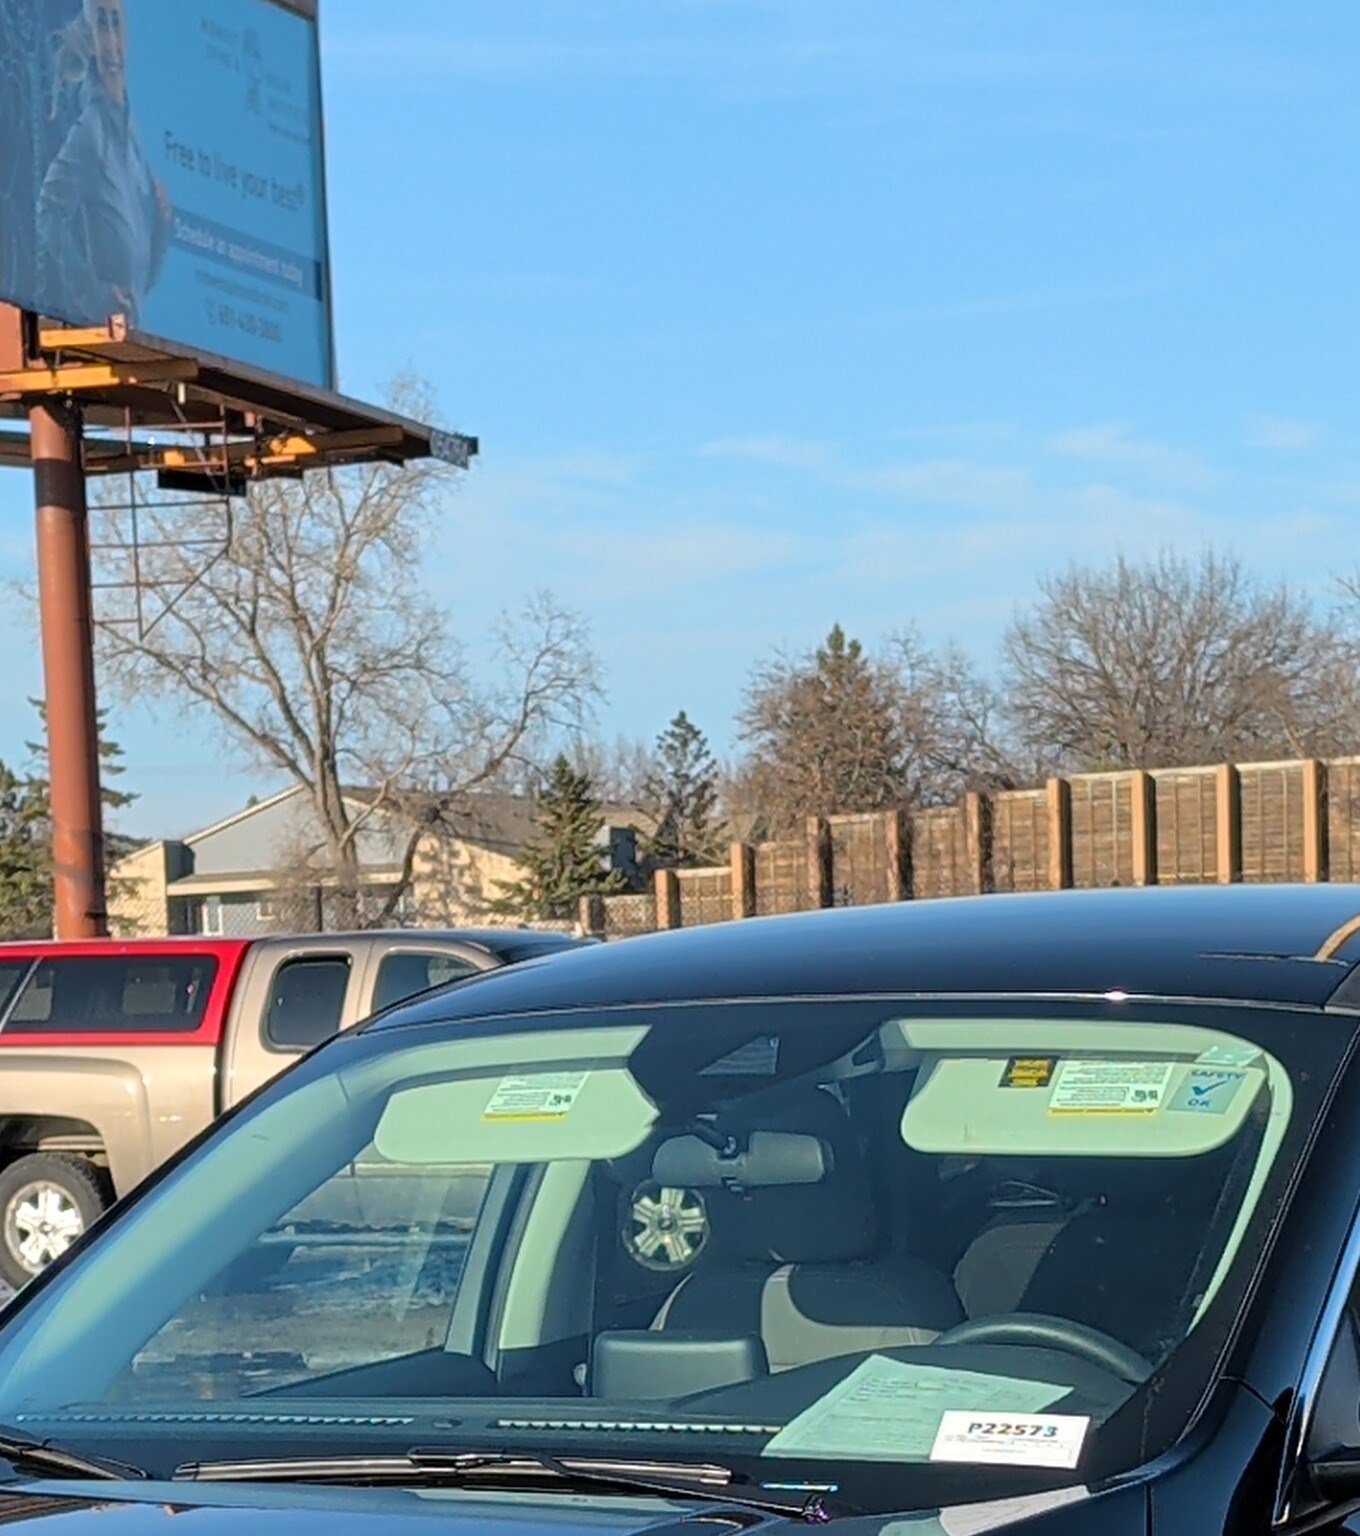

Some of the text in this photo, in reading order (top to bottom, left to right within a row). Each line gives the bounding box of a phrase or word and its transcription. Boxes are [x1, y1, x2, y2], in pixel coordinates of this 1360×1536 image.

[1191, 1069, 1247, 1080] SAFETY
[1188, 1098, 1211, 1107] OK
[967, 1421, 1059, 1438] P22573
